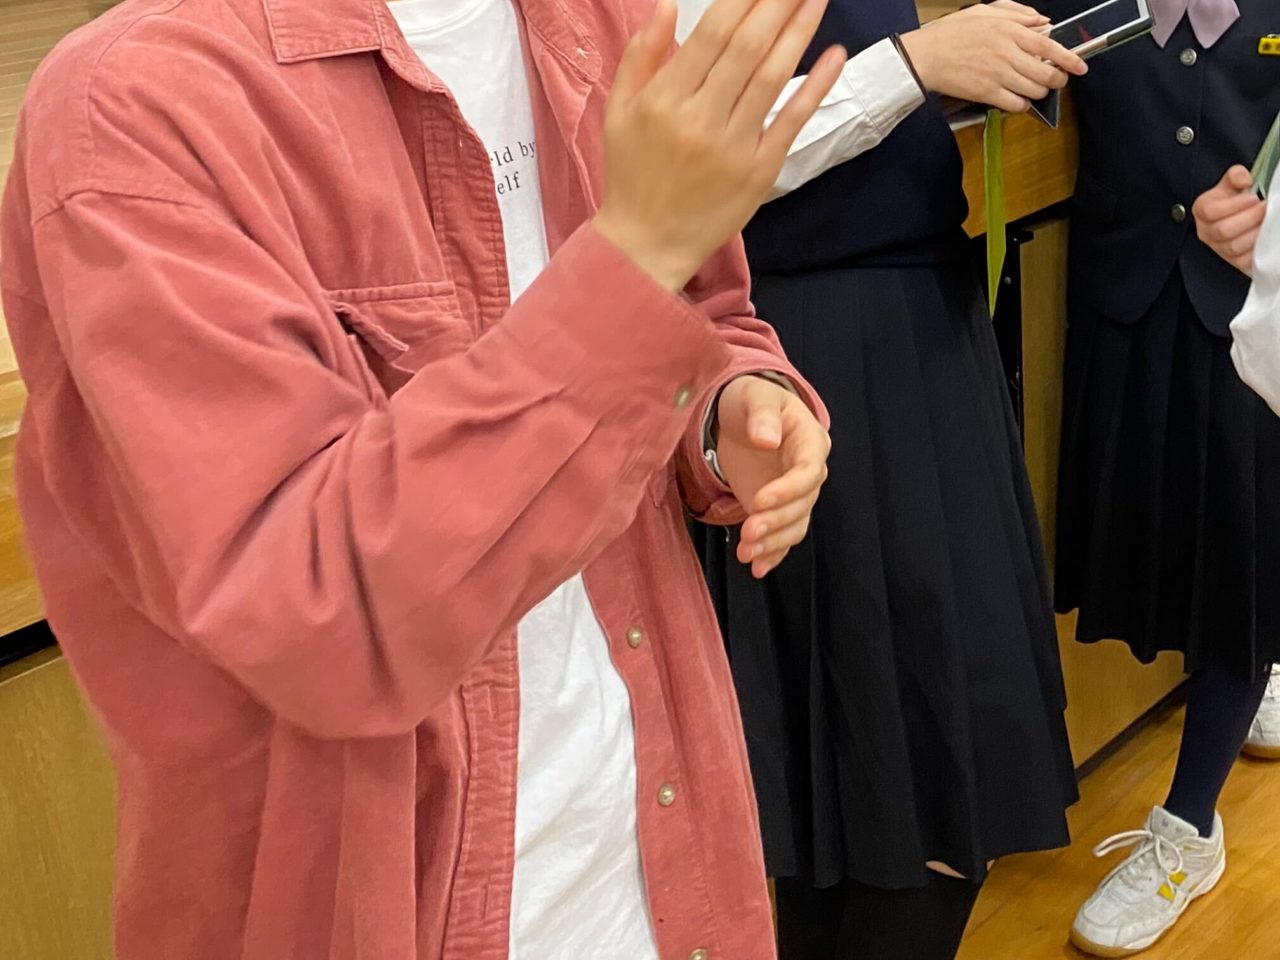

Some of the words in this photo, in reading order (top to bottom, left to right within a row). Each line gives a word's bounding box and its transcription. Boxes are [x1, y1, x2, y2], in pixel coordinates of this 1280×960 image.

[490, 147, 514, 167] ld
[517, 141, 536, 158] by
[497, 171, 521, 195] elf
